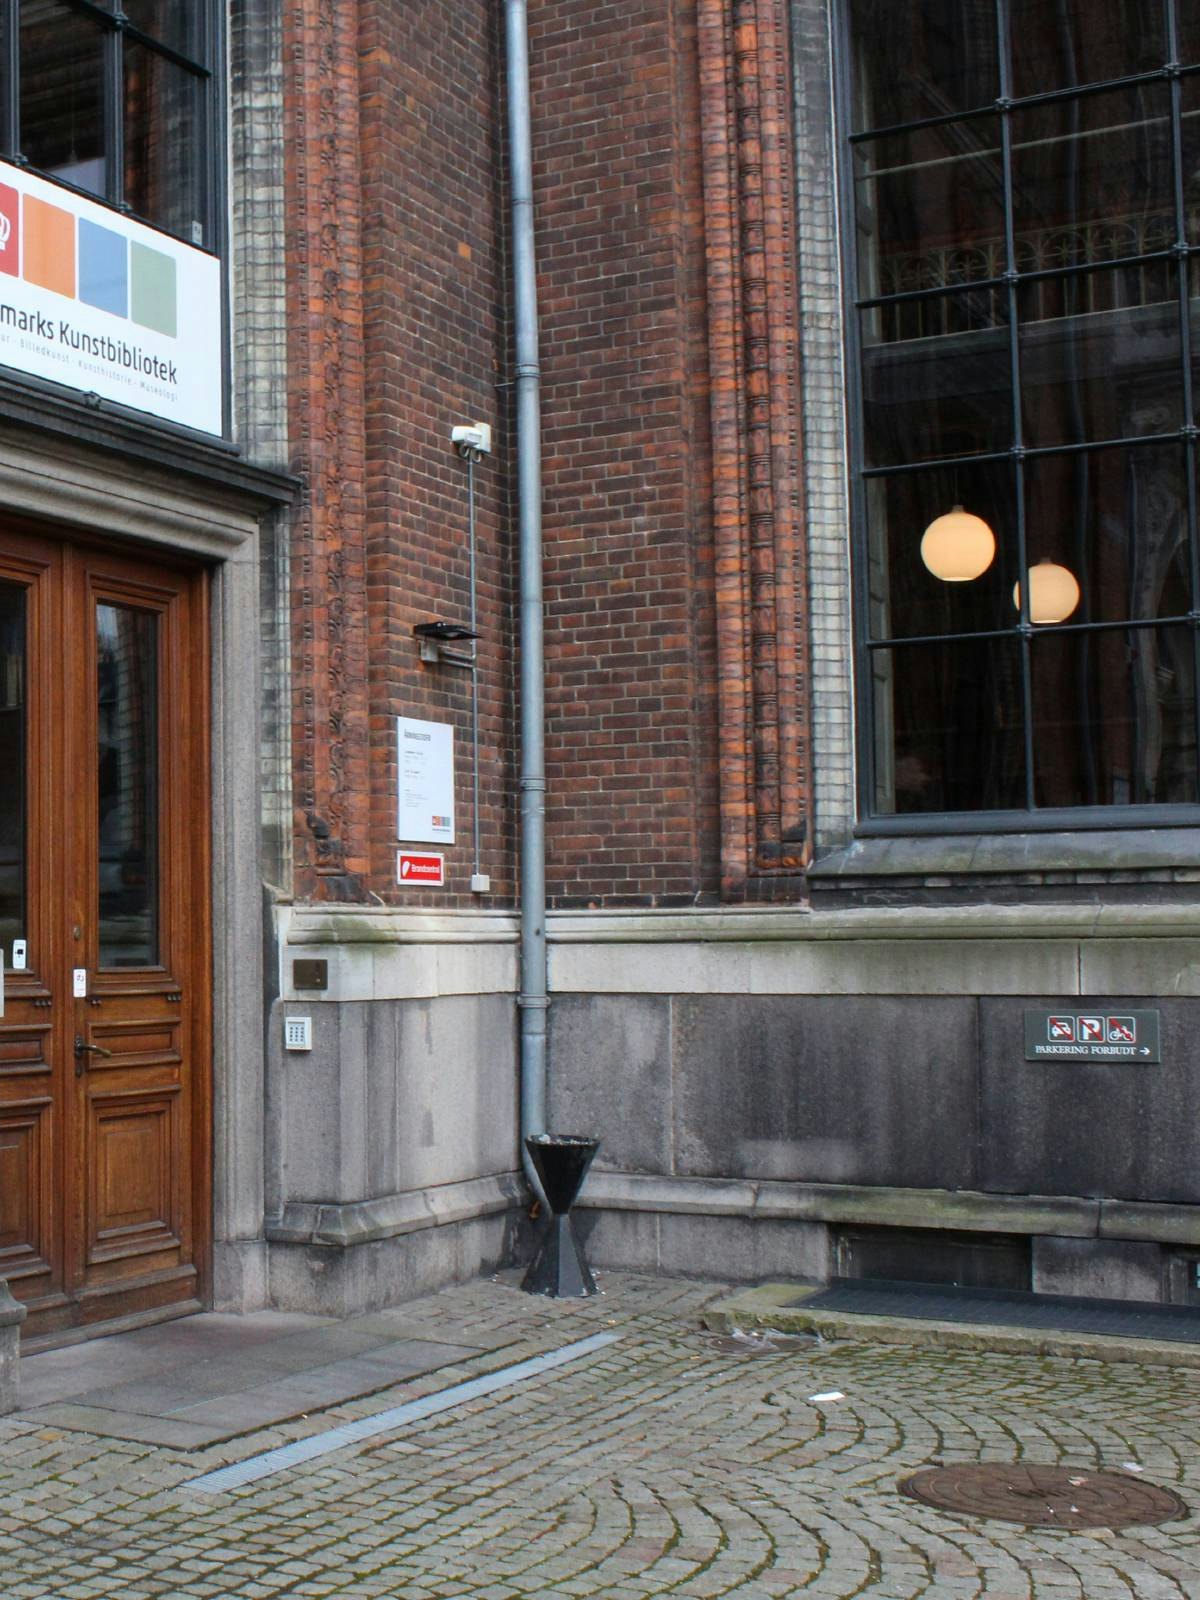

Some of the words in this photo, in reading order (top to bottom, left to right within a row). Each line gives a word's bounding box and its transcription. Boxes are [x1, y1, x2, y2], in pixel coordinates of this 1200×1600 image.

[20, 338, 70, 363] Billedkunst
[59, 319, 178, 385] Kunstbibliotek
[1035, 1045, 1088, 1055] PARKERING
[1091, 1046, 1137, 1055] FORBUDT
